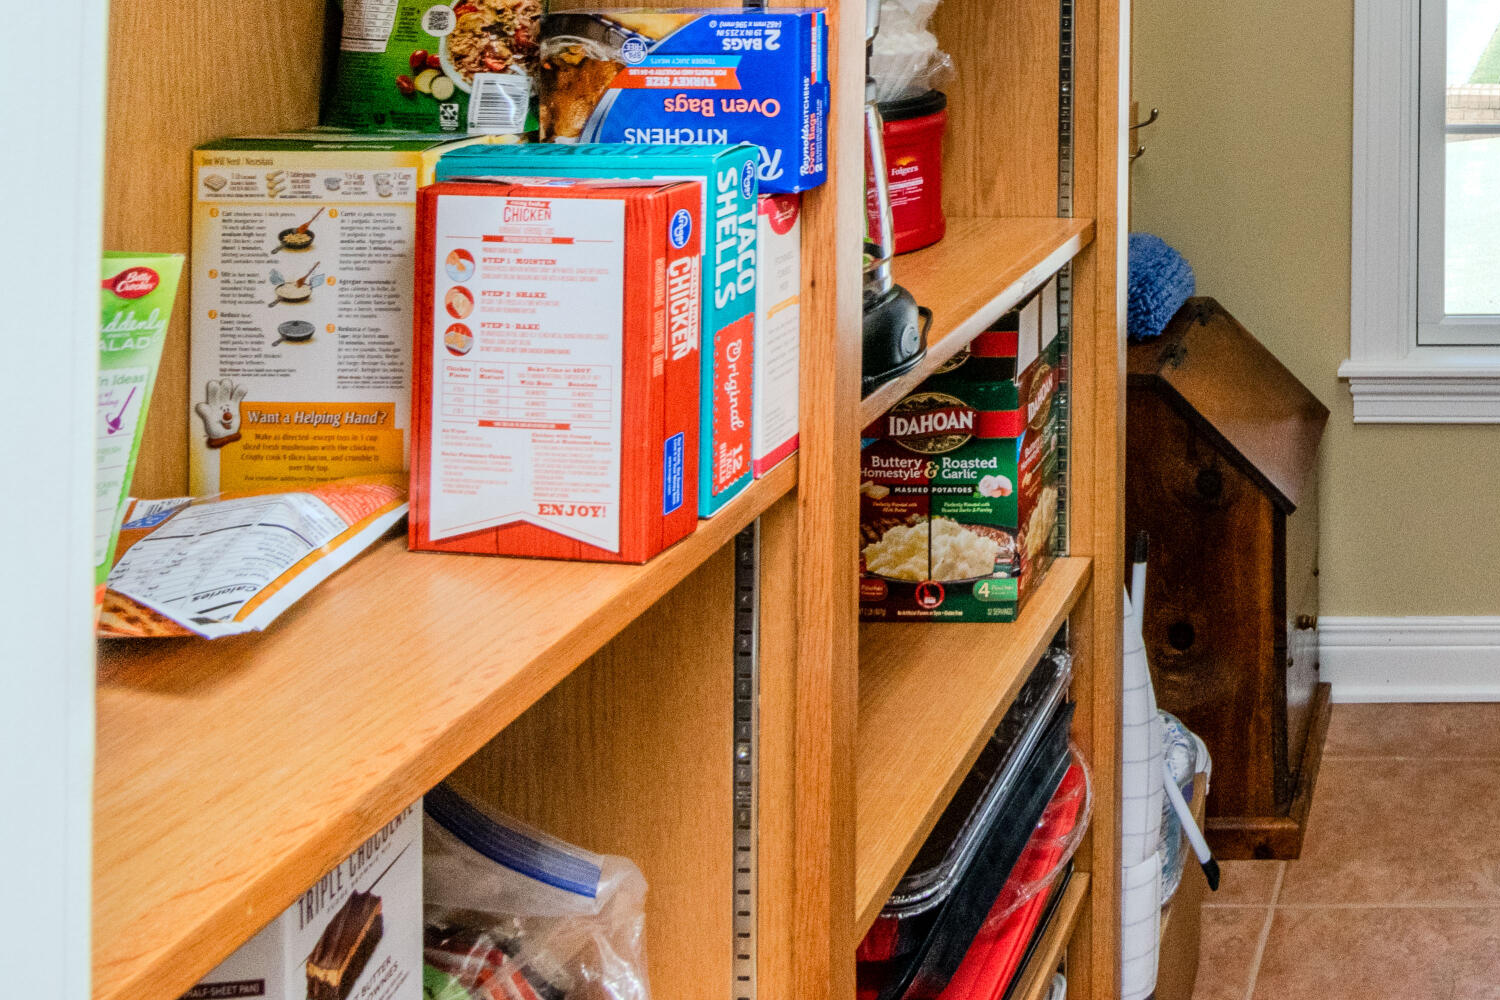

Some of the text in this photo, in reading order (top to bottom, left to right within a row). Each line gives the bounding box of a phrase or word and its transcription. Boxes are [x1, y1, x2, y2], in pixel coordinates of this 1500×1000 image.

[722, 29, 781, 50] 2 BAGS
[645, 76, 717, 88] TURKEY SIZE
[663, 94, 782, 118] Oven Bags
[890, 164, 920, 177] Folgers
[503, 206, 552, 223] CHICKEN
[714, 166, 738, 309] SHELLS
[736, 203, 758, 295] TACO
[482, 256, 505, 265] STEP
[515, 257, 557, 266] MOISTEN
[481, 289, 504, 298] STEP
[515, 290, 548, 299] SHAKE
[669, 256, 692, 361] CHICKEN
[480, 321, 541, 331] STEP BAKE
[97, 336, 151, 352] ALAD
[723, 338, 745, 432] Original
[248, 411, 281, 424] Want
[283, 413, 291, 424] a
[294, 411, 342, 427] Helping
[888, 409, 975, 437] IDAHOAN
[730, 443, 743, 473] 12
[871, 456, 924, 471] Buttery
[941, 455, 998, 470] Roasted
[941, 468, 978, 481] Garlic
[893, 485, 973, 495] MASHED POTATOES
[537, 502, 607, 519] ENJOY!
[977, 581, 991, 598] 4
[297, 863, 344, 931] TRIPLE
